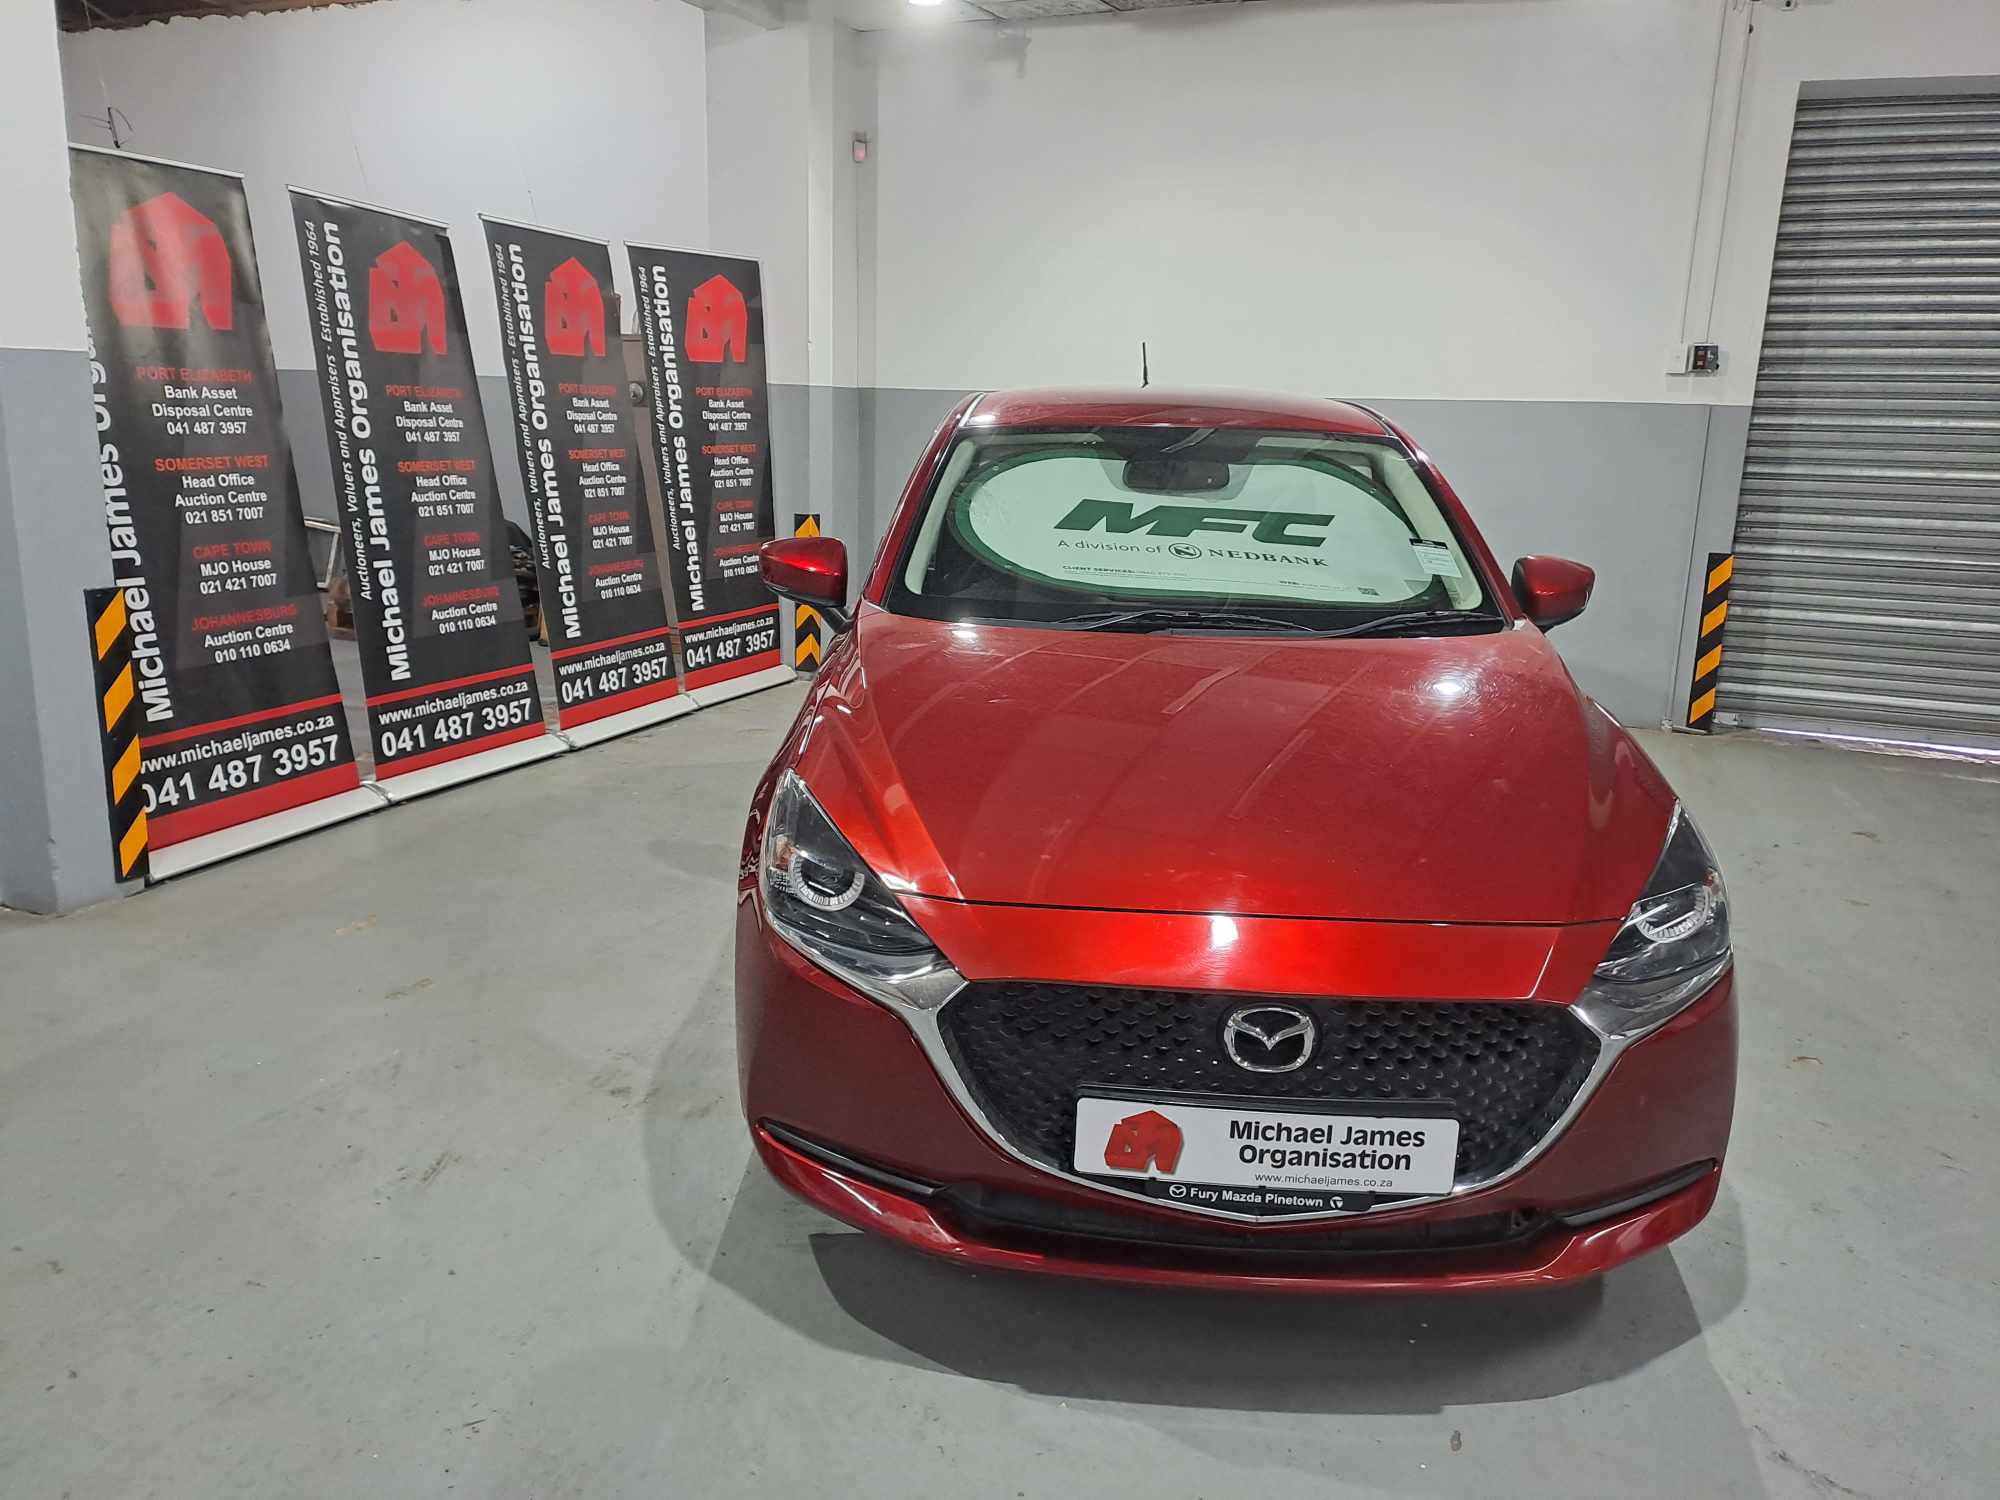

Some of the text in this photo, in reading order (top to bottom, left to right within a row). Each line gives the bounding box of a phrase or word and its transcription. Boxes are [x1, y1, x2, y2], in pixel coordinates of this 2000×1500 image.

[500, 275, 517, 347] Established
[136, 367, 175, 380] PORT
[164, 385, 238, 399] Bank Asset
[512, 358, 528, 425] Appraisers
[152, 404, 253, 419] Disposal Centre
[304, 220, 372, 600] Auctioneers, Valuers and Appraisers Established 1964
[404, 401, 453, 413] Bank Asset
[566, 411, 596, 422] Disposal
[638, 266, 681, 550] Auctioneers, Valuers and Appraisers Established 1964
[167, 422, 247, 435] 041 487 3957
[396, 416, 464, 429] Disposal Centre
[406, 432, 421, 442] 041
[424, 431, 440, 441] 487
[509, 243, 582, 639] Michael James Organisation
[520, 425, 531, 447] and
[653, 265, 705, 611] Michael James Organisation
[323, 221, 411, 681] Michael James Organisation
[154, 455, 269, 471] SOMERSET WEST
[525, 450, 537, 494] Valuers
[582, 462, 619, 472] Head Office
[182, 474, 255, 488] Head Office
[416, 475, 467, 487] Head Office
[579, 475, 626, 485] Auction Centre
[175, 491, 267, 507] Auction Centre
[411, 489, 476, 502] Auction Centre
[185, 507, 264, 524] 021 851 7007
[418, 504, 474, 517] 021 851 7007
[608, 526, 629, 534] House
[1054, 499, 1336, 547] MFC
[533, 498, 550, 569] Auctioneers,
[605, 537, 617, 547] 421
[193, 541, 272, 558] CAPE TOWN
[429, 548, 480, 561] MJO House
[1058, 540, 1328, 567] A division of NEDBANK
[200, 560, 272, 576] MJO House
[429, 560, 485, 576] 021 421 7007
[100, 443, 174, 722] Michael James
[200, 573, 277, 595] 021 421 7007
[595, 576, 620, 587] Auction
[432, 602, 497, 620] Auction Centre
[439, 615, 496, 634] 010 110 0634
[685, 617, 773, 643] www.michaeljames.co.za
[204, 624, 294, 648] Auction Centre
[215, 639, 291, 664] 010 110 0634
[559, 641, 665, 676] www.michaeljames.co.za
[687, 630, 774, 668] 041 487 3957
[561, 657, 667, 703] 041 487 3957
[378, 681, 528, 725] www.michaeljames.co.za
[381, 698, 532, 757] 041 487 3957
[208, 755, 263, 793] 487
[274, 734, 339, 777] 3957
[1229, 1120, 1425, 1147] Michael James
[1239, 1143, 1411, 1171] Organisation
[1255, 1172, 1394, 1188] www.michaeljames.co.za
[1190, 1187, 1323, 1208] Fury Mazda Pinetown
